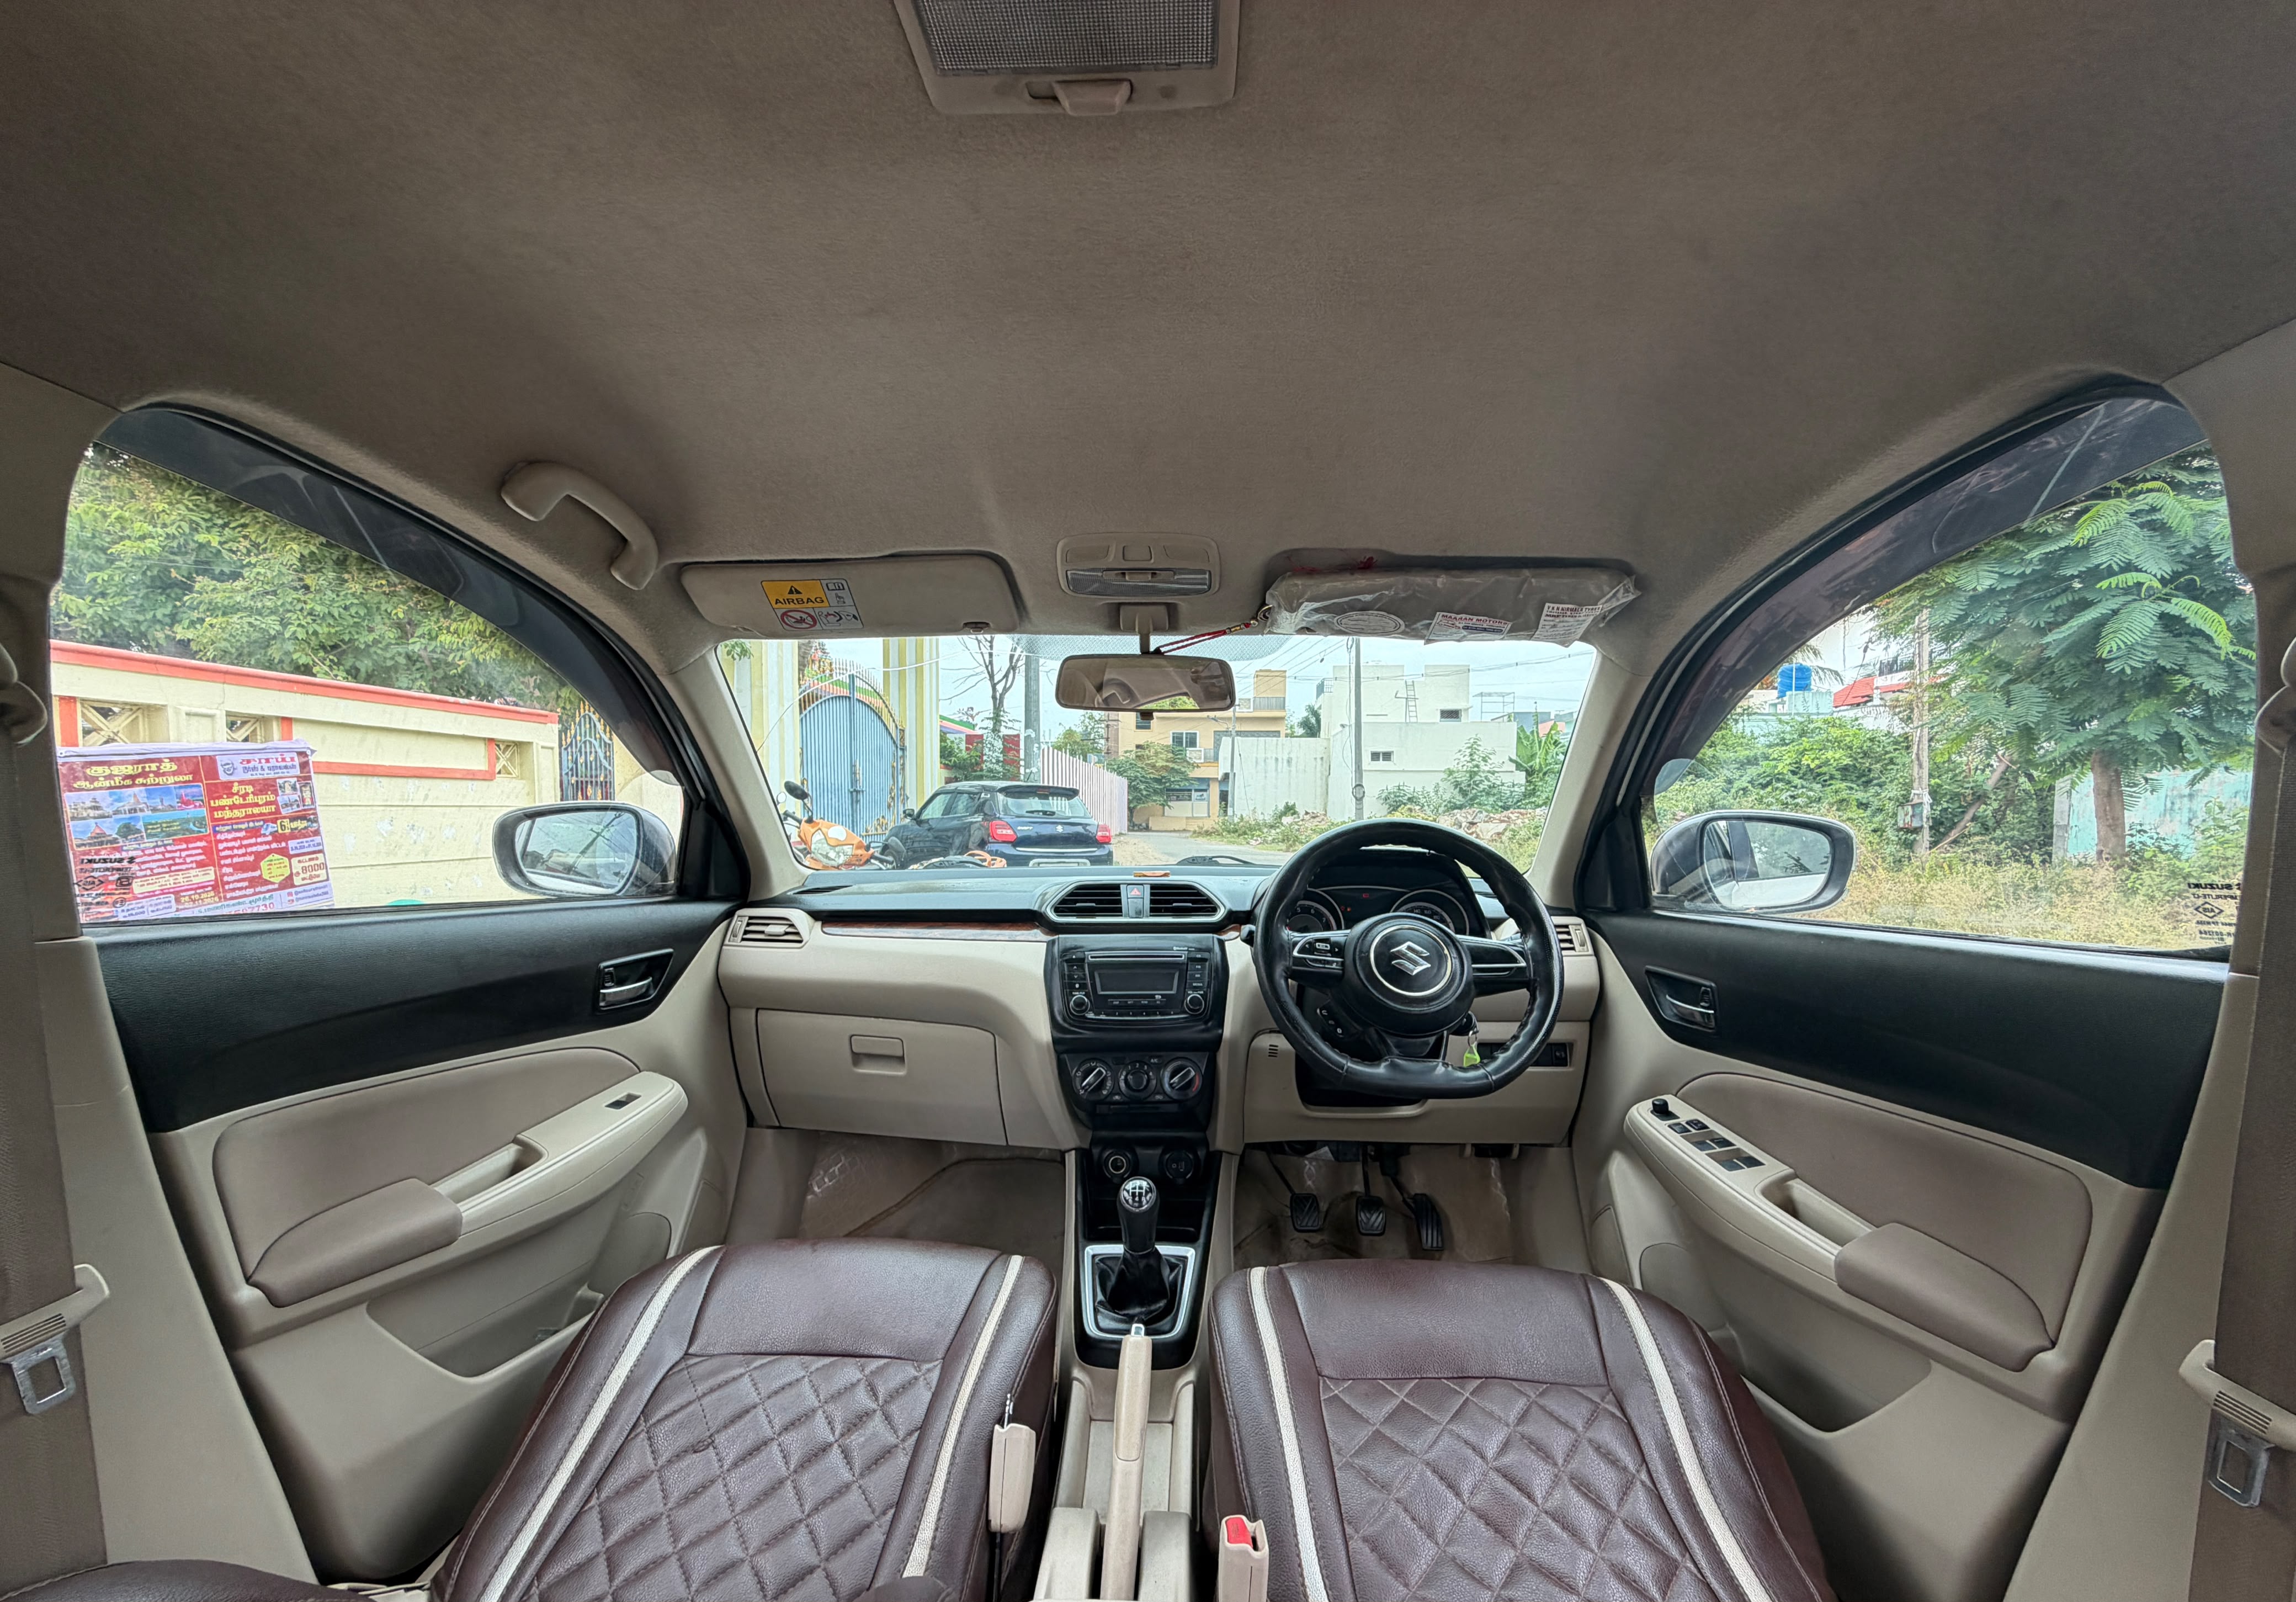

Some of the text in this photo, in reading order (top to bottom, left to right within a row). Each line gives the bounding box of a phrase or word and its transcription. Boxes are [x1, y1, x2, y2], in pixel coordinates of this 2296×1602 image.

[774, 597, 825, 606] AIRBAG
[86, 758, 178, 776] குஜராத்
[73, 773, 193, 790] ஆன்மீக சுற்றுலா
[232, 782, 254, 794] சீரடி
[279, 820, 286, 831] 6
[301, 862, 325, 874] 8000
